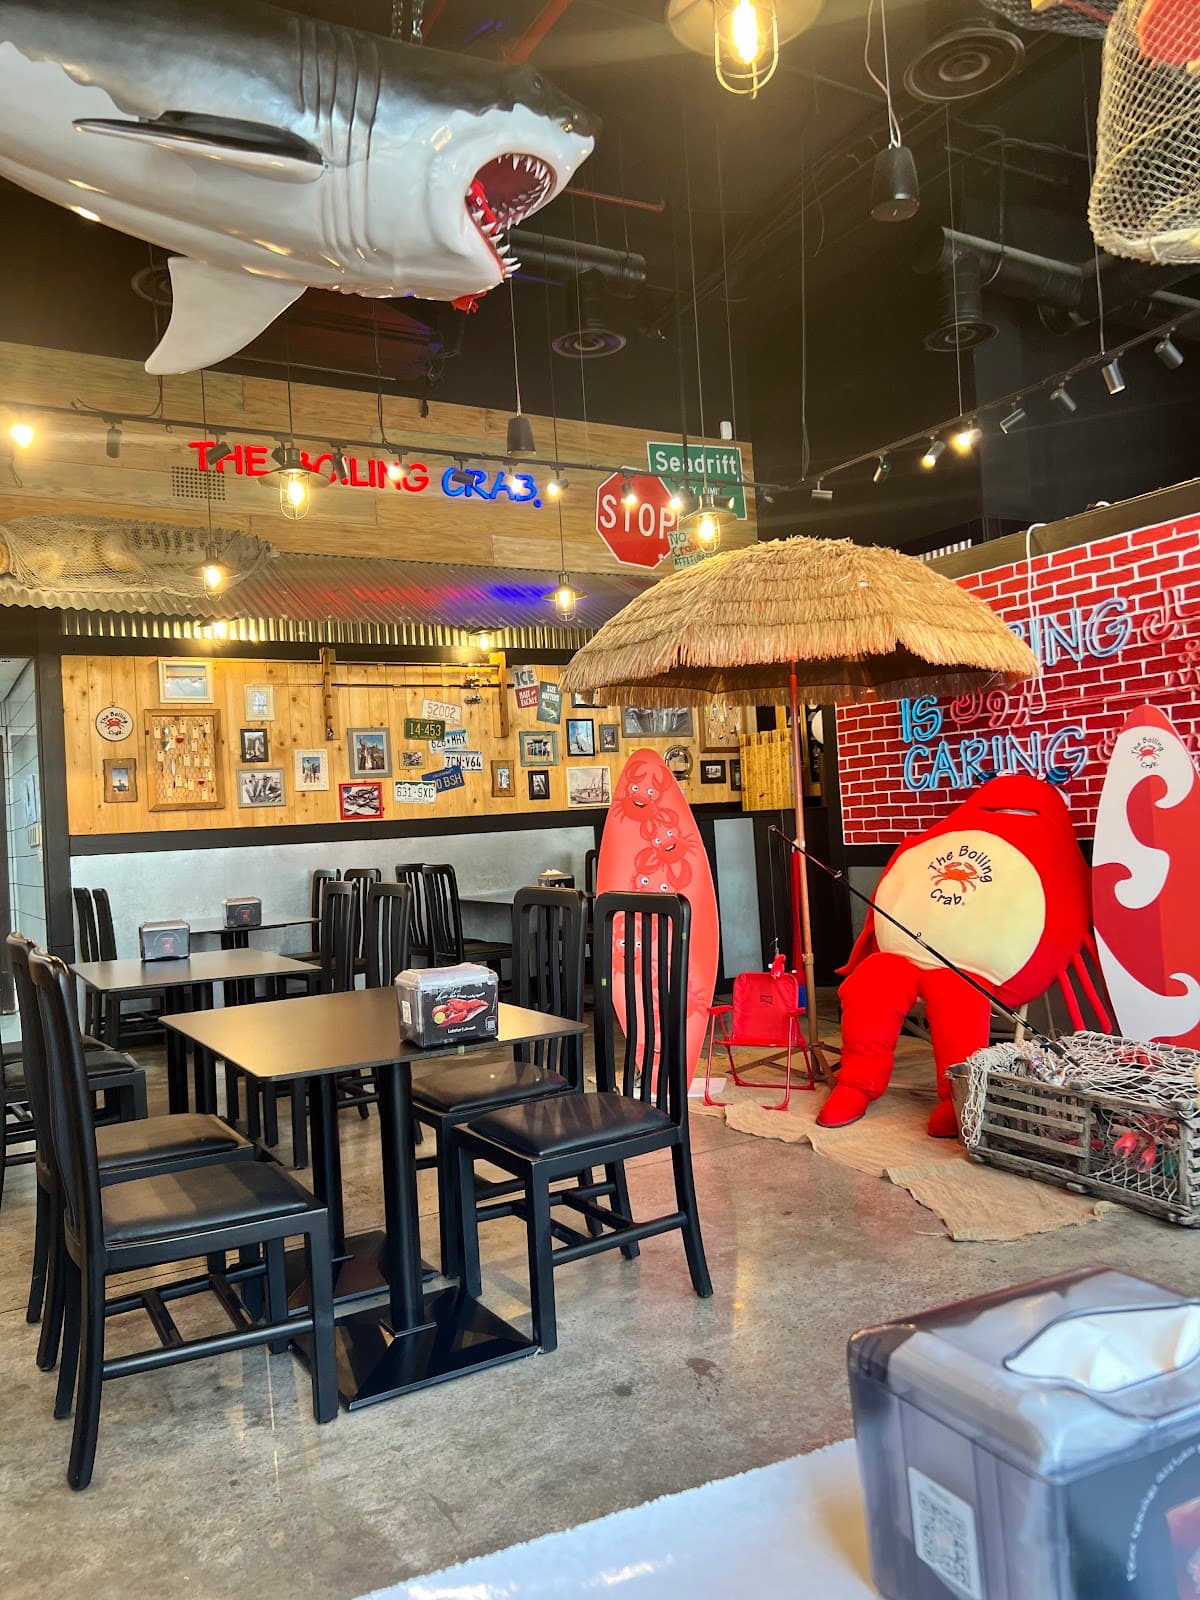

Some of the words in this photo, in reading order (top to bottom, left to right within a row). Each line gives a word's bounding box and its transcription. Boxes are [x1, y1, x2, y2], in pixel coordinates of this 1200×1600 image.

[188, 441, 270, 476] THE
[655, 450, 737, 475] Seadrift
[600, 494, 676, 540] STOP
[514, 669, 535, 686] ICE
[409, 722, 441, 737] 14-453
[900, 695, 942, 743] IS
[903, 725, 1090, 792] CARING
[928, 851, 954, 871] The
[958, 845, 993, 883] Boiling
